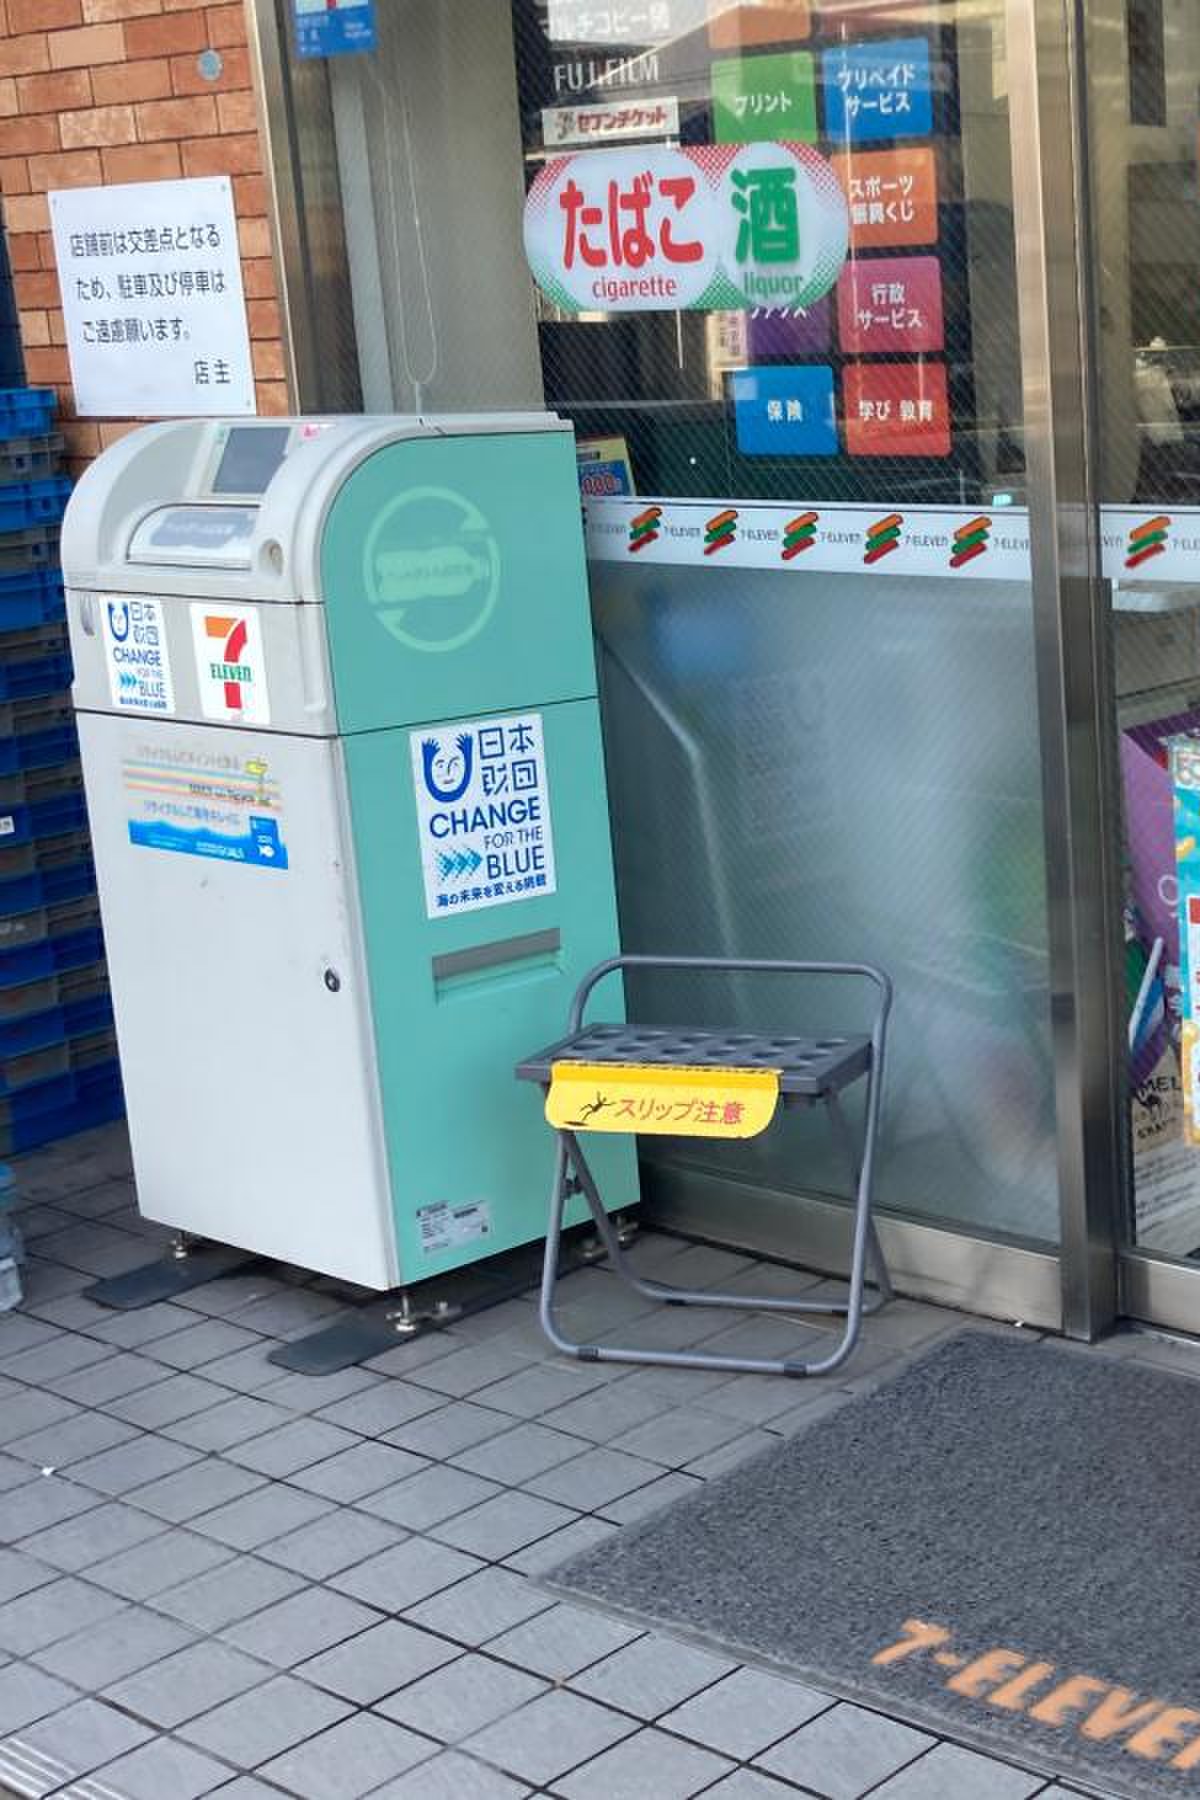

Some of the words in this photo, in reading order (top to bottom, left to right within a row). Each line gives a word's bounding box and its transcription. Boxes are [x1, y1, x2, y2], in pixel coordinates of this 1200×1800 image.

[553, 55, 660, 91] FUJIFILM
[838, 63, 915, 91] プリペイド
[734, 91, 793, 117] プリント
[845, 89, 912, 114] サービス
[848, 175, 914, 198] スポーツ
[559, 171, 704, 270] たばこ
[730, 167, 800, 265] 酒
[69, 223, 221, 258] 店舗前は交差点となる
[75, 268, 226, 302] ため、駐車及び停車は
[591, 275, 678, 302] cigarette
[743, 271, 804, 296] liquor
[870, 282, 906, 306] 行政
[81, 317, 193, 343] ご遠慮願います。
[856, 309, 923, 331] サービス
[193, 358, 231, 386] 店主
[112, 646, 162, 667] CHANGE
[209, 663, 252, 683] ELEVEN
[138, 680, 167, 699] BLUE
[478, 722, 535, 760] 日本
[429, 796, 542, 839] CHANGE
[483, 830, 515, 849] FOR
[518, 825, 544, 845] THE
[486, 846, 545, 880] BLUE
[613, 1097, 745, 1125] スリップ注意
